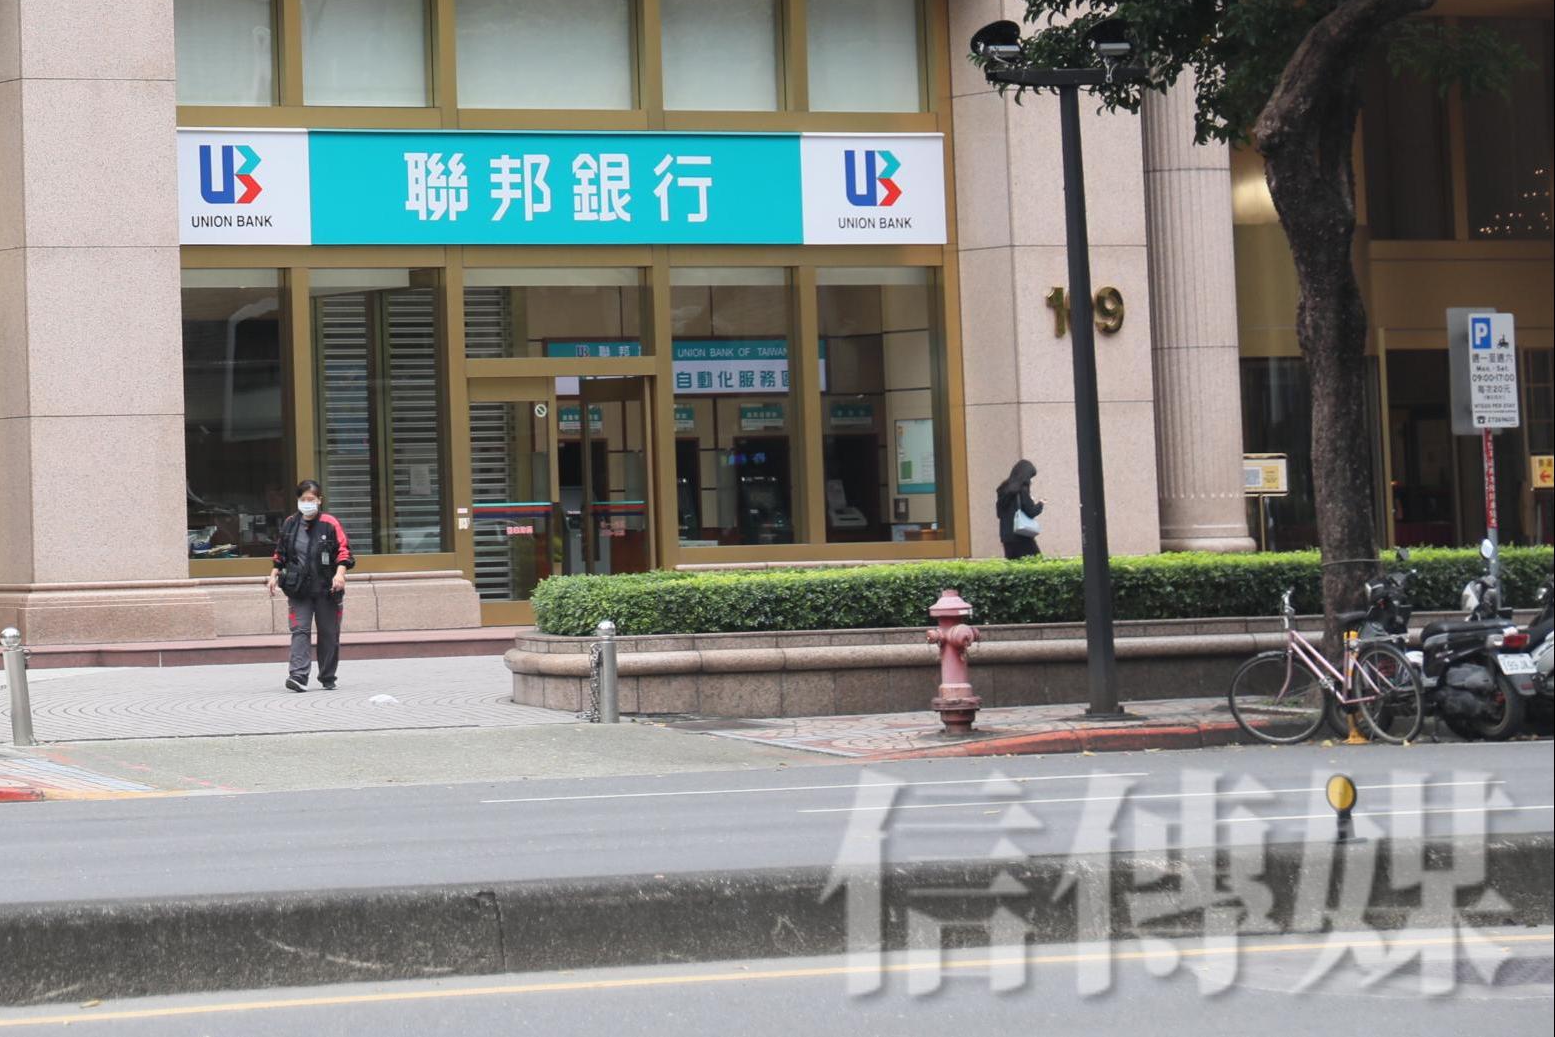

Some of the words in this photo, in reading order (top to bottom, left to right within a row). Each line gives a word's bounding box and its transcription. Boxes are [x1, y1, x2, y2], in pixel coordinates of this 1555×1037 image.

[403, 151, 713, 223] 聯邦銀行
[191, 215, 233, 228] UNION
[237, 215, 273, 227] BANK
[838, 217, 876, 229] UNION
[879, 217, 912, 229] BANK
[1046, 287, 1124, 338] 19
[1475, 322, 1488, 345] P
[677, 348, 706, 357] UNION
[709, 348, 734, 356] BANK
[737, 347, 751, 356] OF
